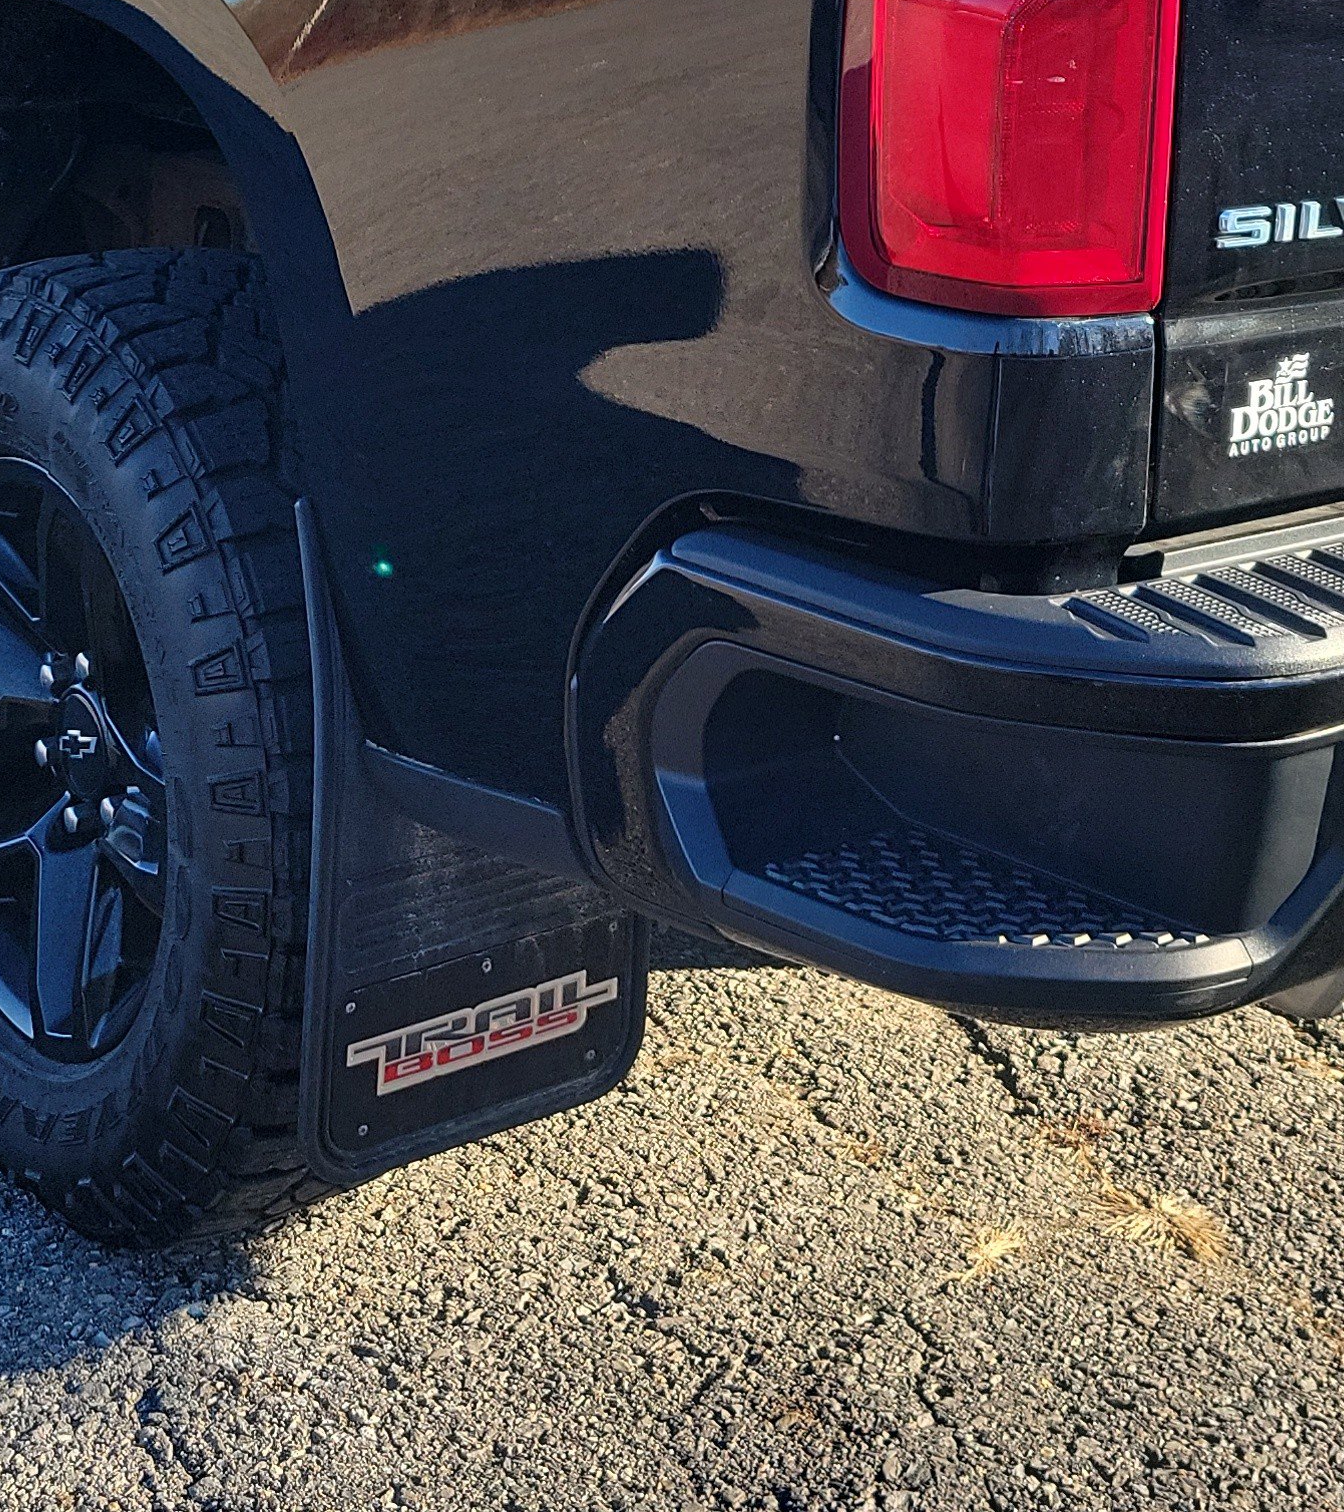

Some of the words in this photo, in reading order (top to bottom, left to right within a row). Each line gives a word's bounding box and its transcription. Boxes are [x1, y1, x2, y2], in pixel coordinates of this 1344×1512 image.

[1248, 379, 1315, 413] BILL
[1228, 437, 1273, 457] AUTO
[1276, 425, 1331, 449] GROUP
[1229, 398, 1335, 443] DODGE
[346, 970, 618, 1066] TRAIL
[378, 1004, 587, 1093] BOSS
